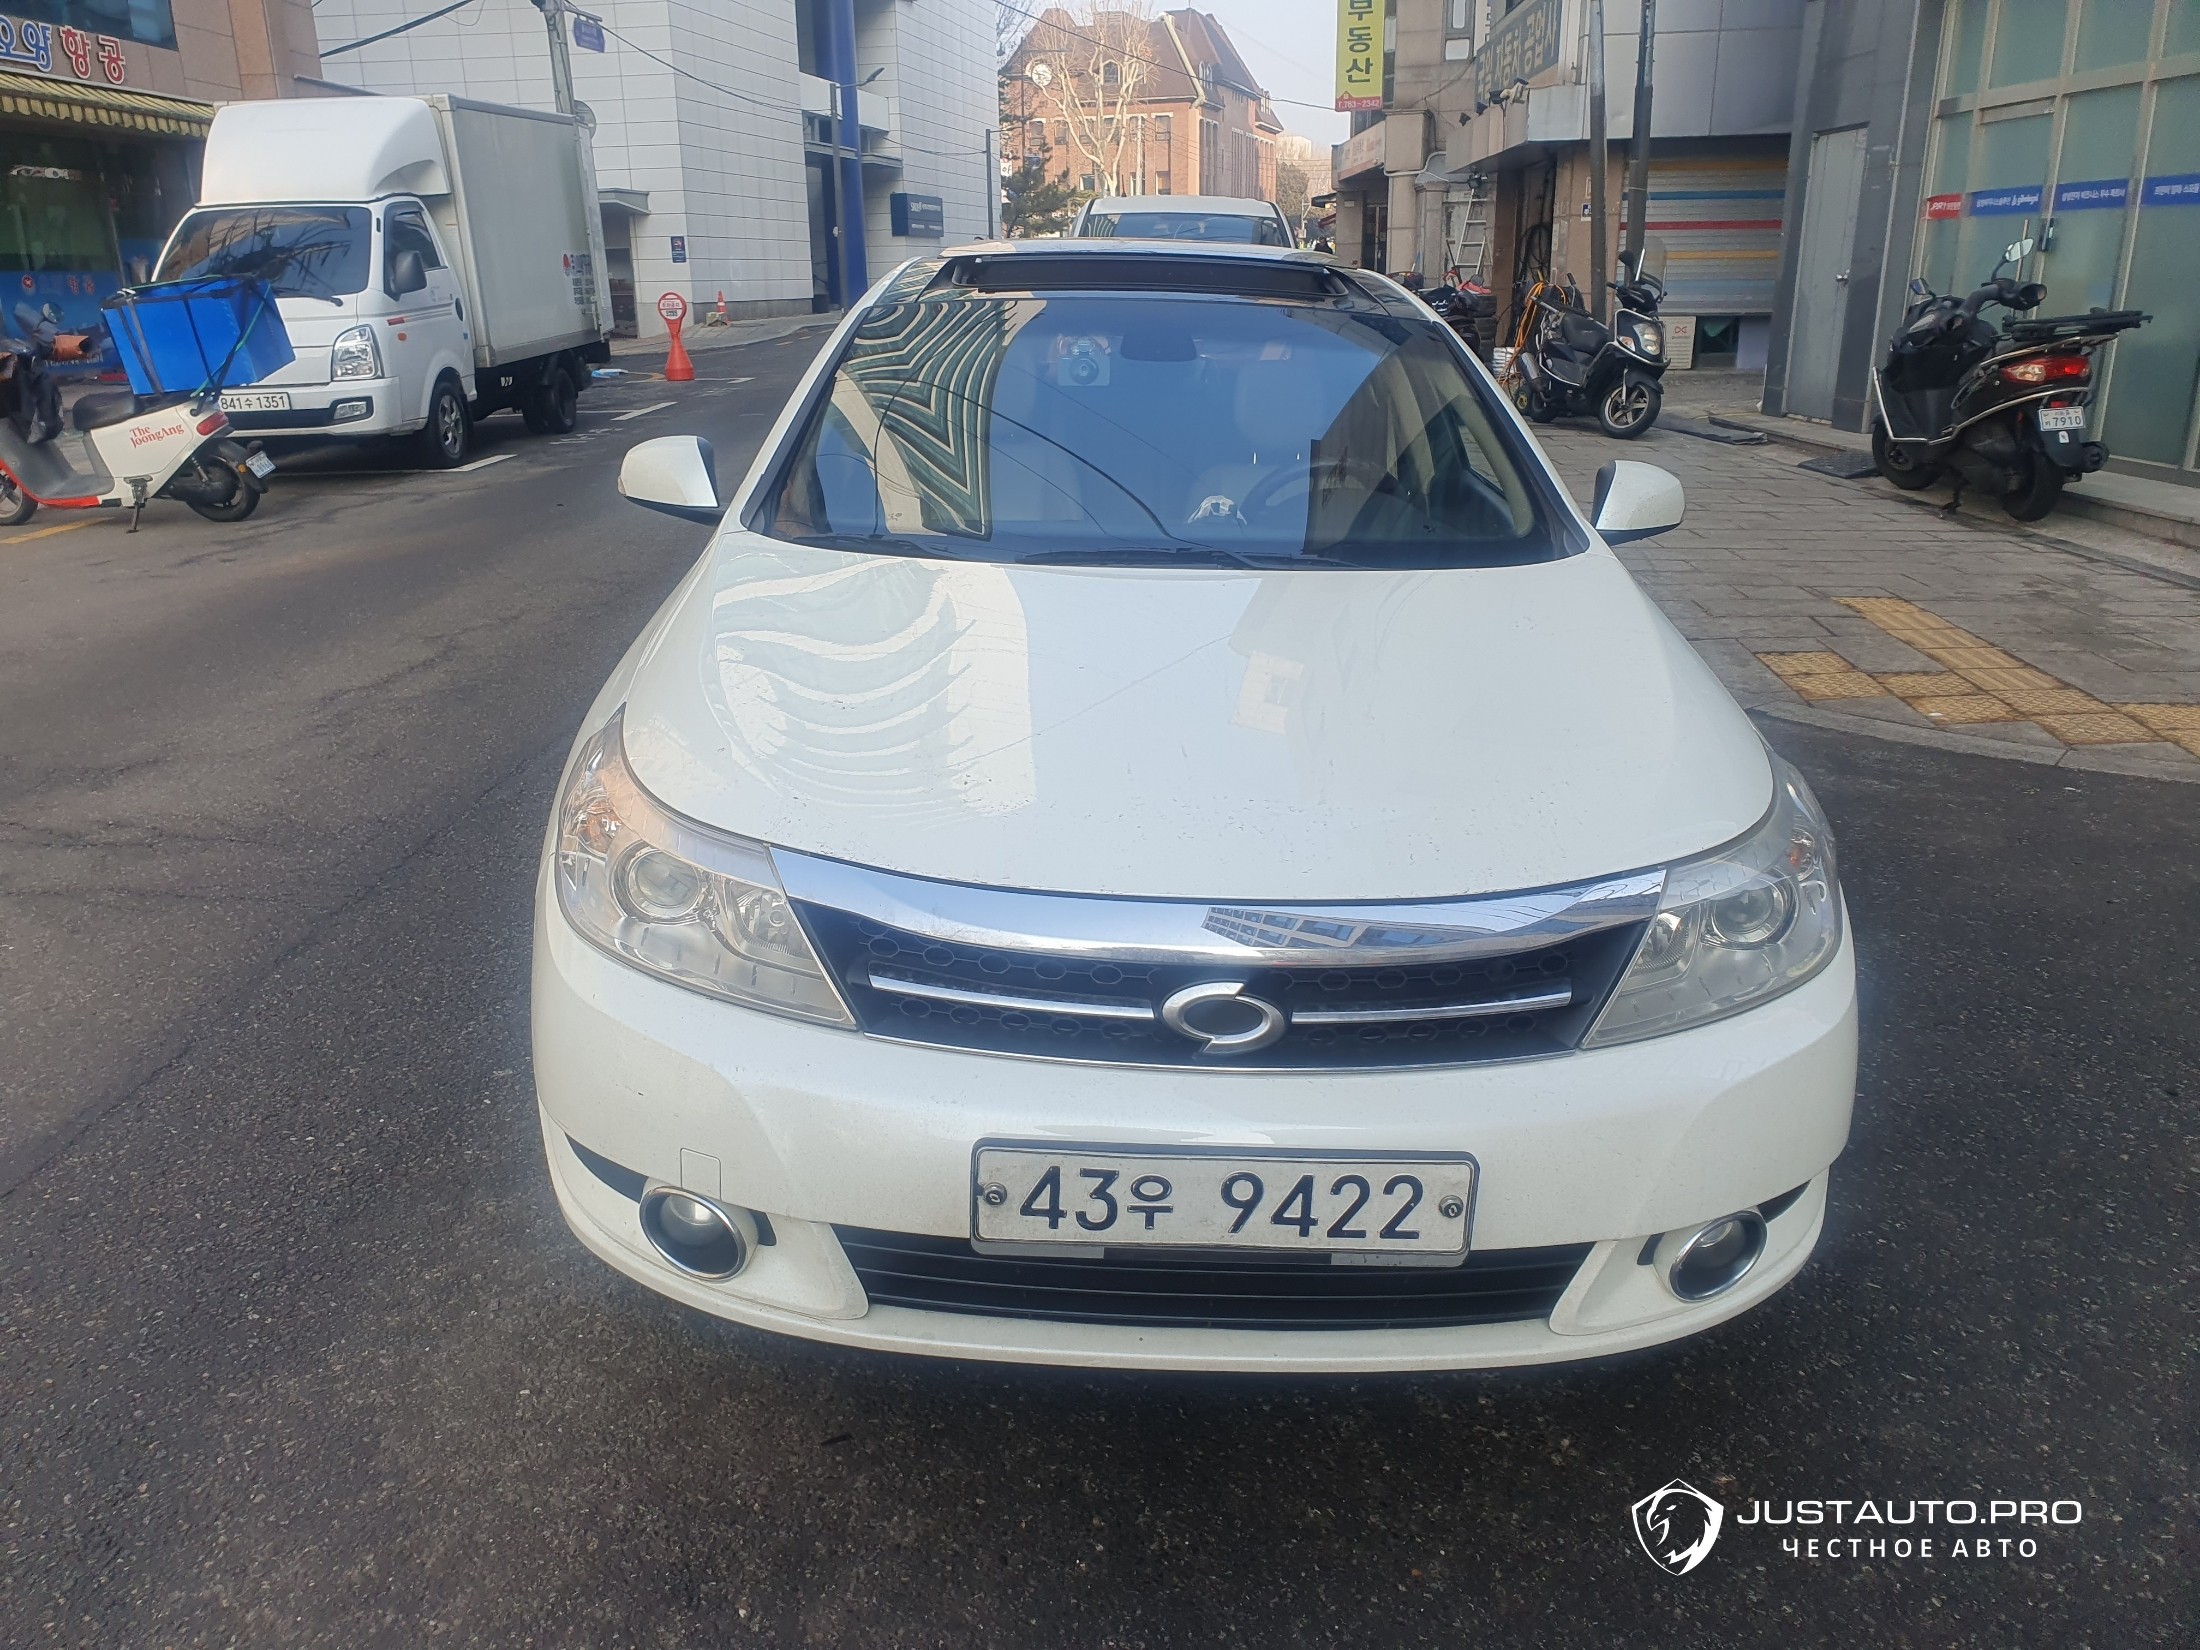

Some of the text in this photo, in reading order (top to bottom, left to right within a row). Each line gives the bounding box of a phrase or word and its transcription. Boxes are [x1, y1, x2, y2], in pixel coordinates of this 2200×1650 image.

[1495, 28, 1522, 88] 자동차
[1523, 1, 1558, 75] 공업사
[129, 426, 151, 438] The
[2052, 415, 2082, 427] 7910
[130, 424, 184, 449] JoongAng
[1019, 1165, 1425, 1240] 43우 9422
